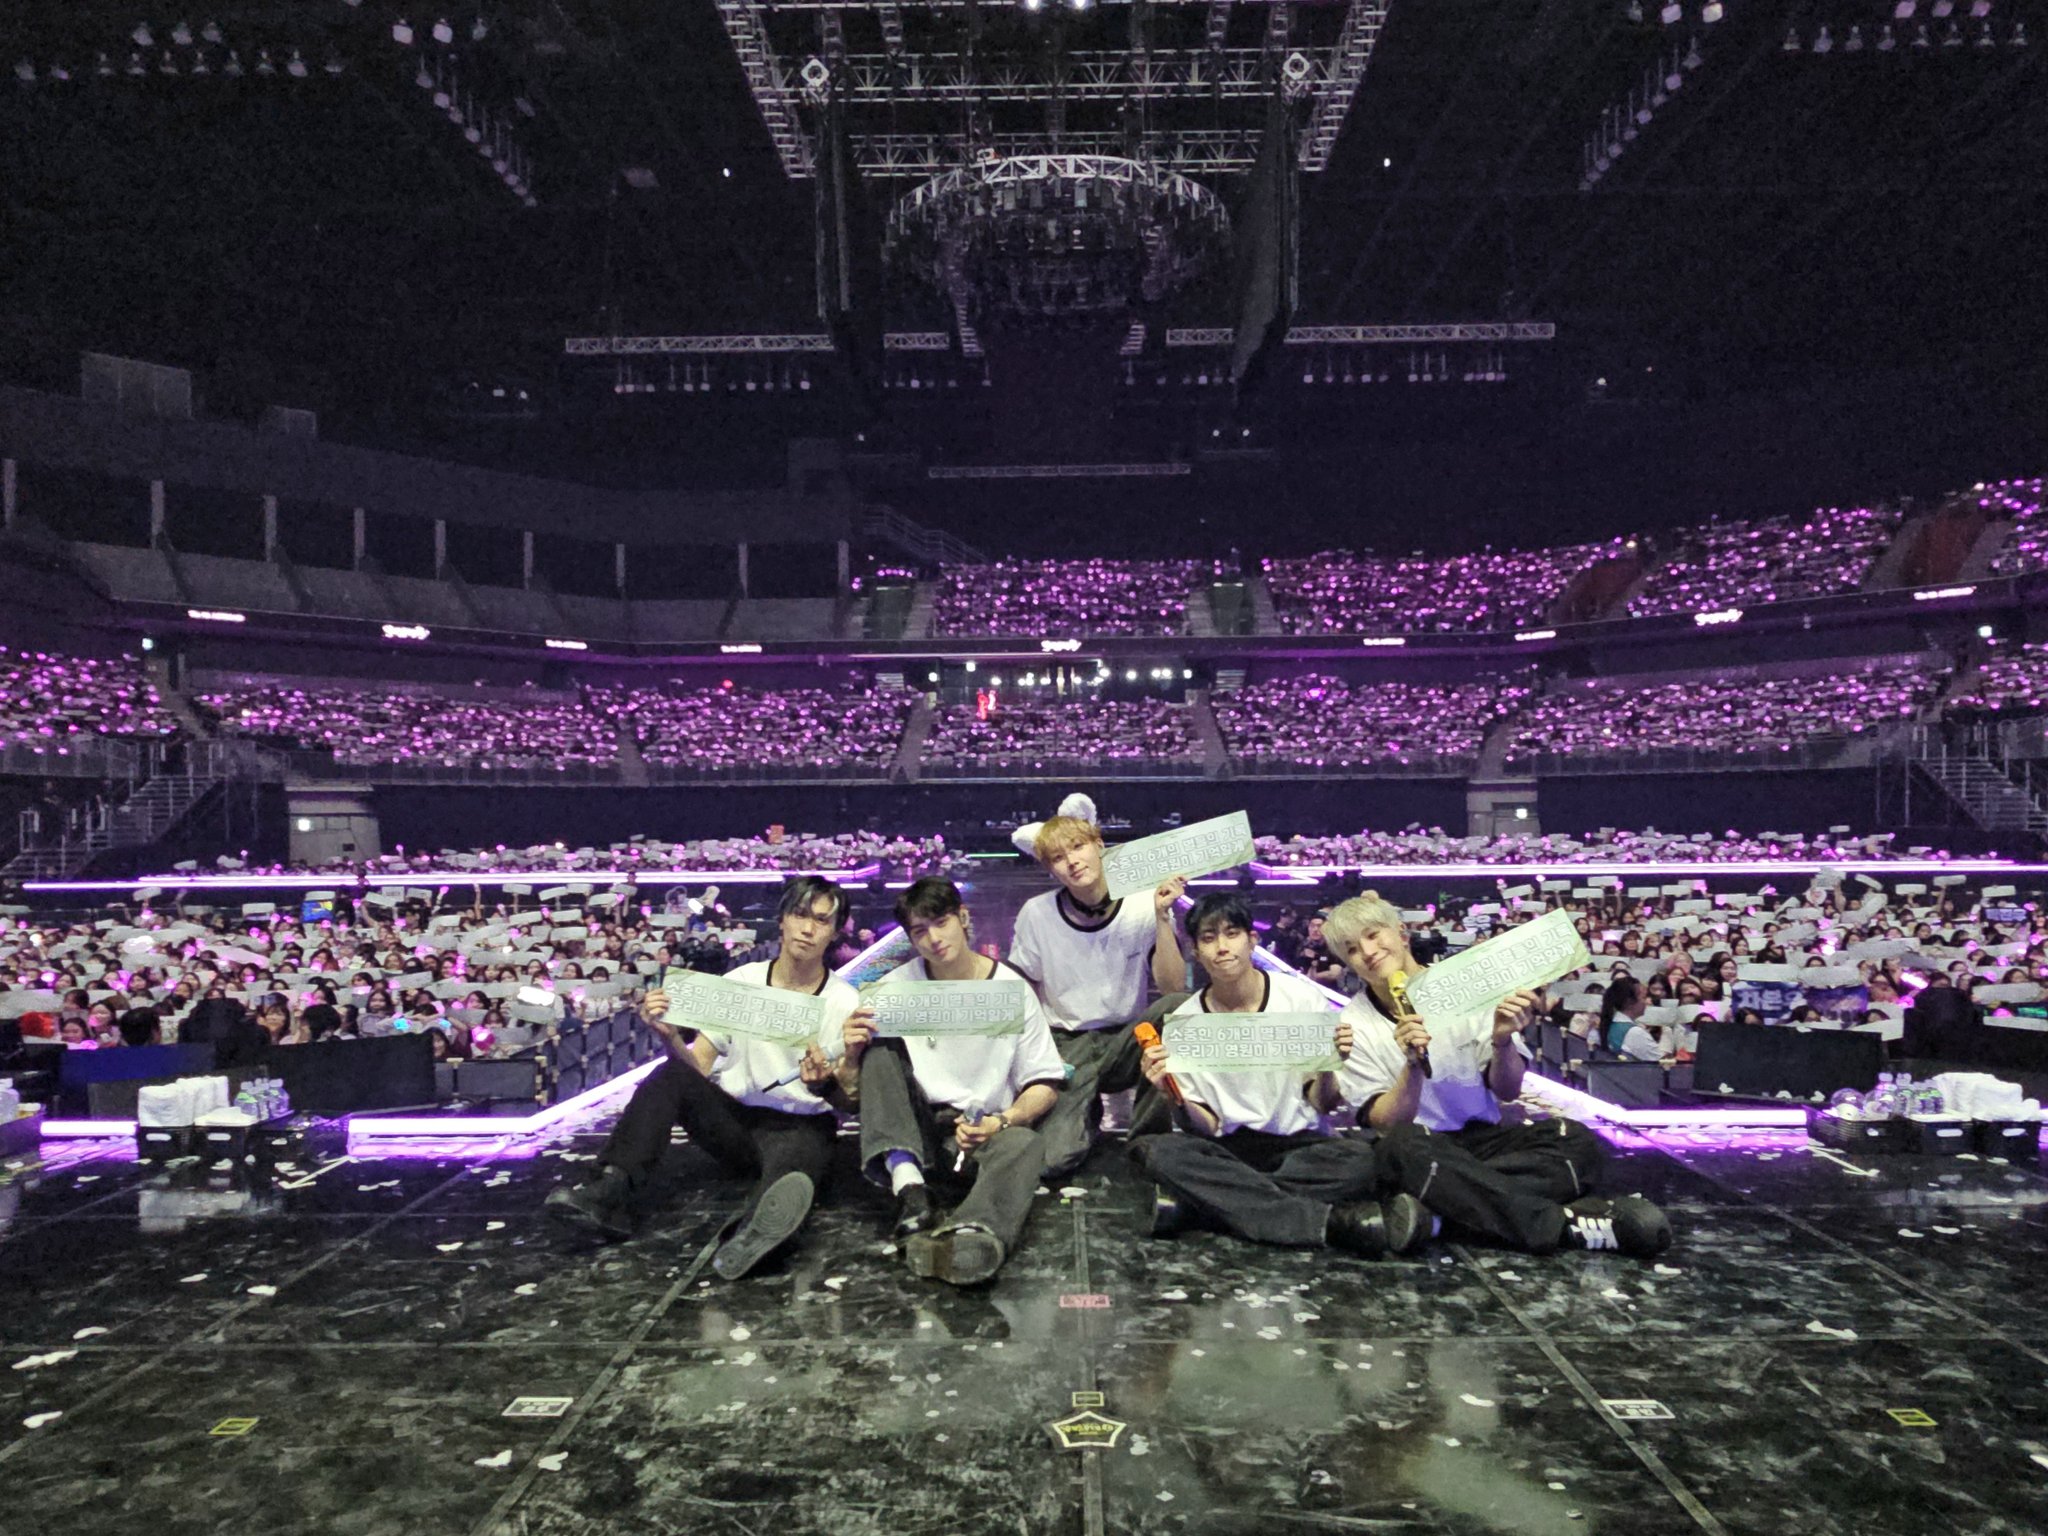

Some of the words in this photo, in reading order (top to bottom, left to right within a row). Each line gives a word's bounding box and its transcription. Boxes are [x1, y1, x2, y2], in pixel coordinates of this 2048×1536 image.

[1106, 852, 1144, 872] 소중한
[1147, 843, 1181, 862] 6개의
[1183, 832, 1219, 851] 별들의
[1221, 823, 1248, 841] 기록
[1116, 866, 1154, 886] 우리가
[1195, 840, 1246, 863] 기억할게
[1414, 973, 1457, 1005] 소중한
[1459, 956, 1497, 984] 6개의
[1499, 936, 1540, 967] 별들의
[1543, 922, 1573, 945] 기록
[1427, 987, 1472, 1017] 우리가
[1519, 942, 1576, 979] 기억할게
[666, 980, 708, 1003] 소중한
[711, 989, 746, 1009] 6개의
[750, 996, 791, 1016] 별들의
[793, 1005, 821, 1023] 기록
[669, 997, 710, 1017] 우리가
[756, 1013, 811, 1037] 기억할게
[862, 994, 904, 1009] 소중한
[907, 993, 945, 1008] 6개의
[949, 992, 990, 1007] 별들의
[993, 991, 1022, 1007] 기록
[959, 1008, 1016, 1023] 기억할게
[1168, 1026, 1213, 1042] 소중한
[1216, 1026, 1256, 1042] 6개의
[1260, 1025, 1304, 1041] 별들의
[1176, 1042, 1220, 1059] 우리가
[1271, 1041, 1332, 1057] 기억할게
